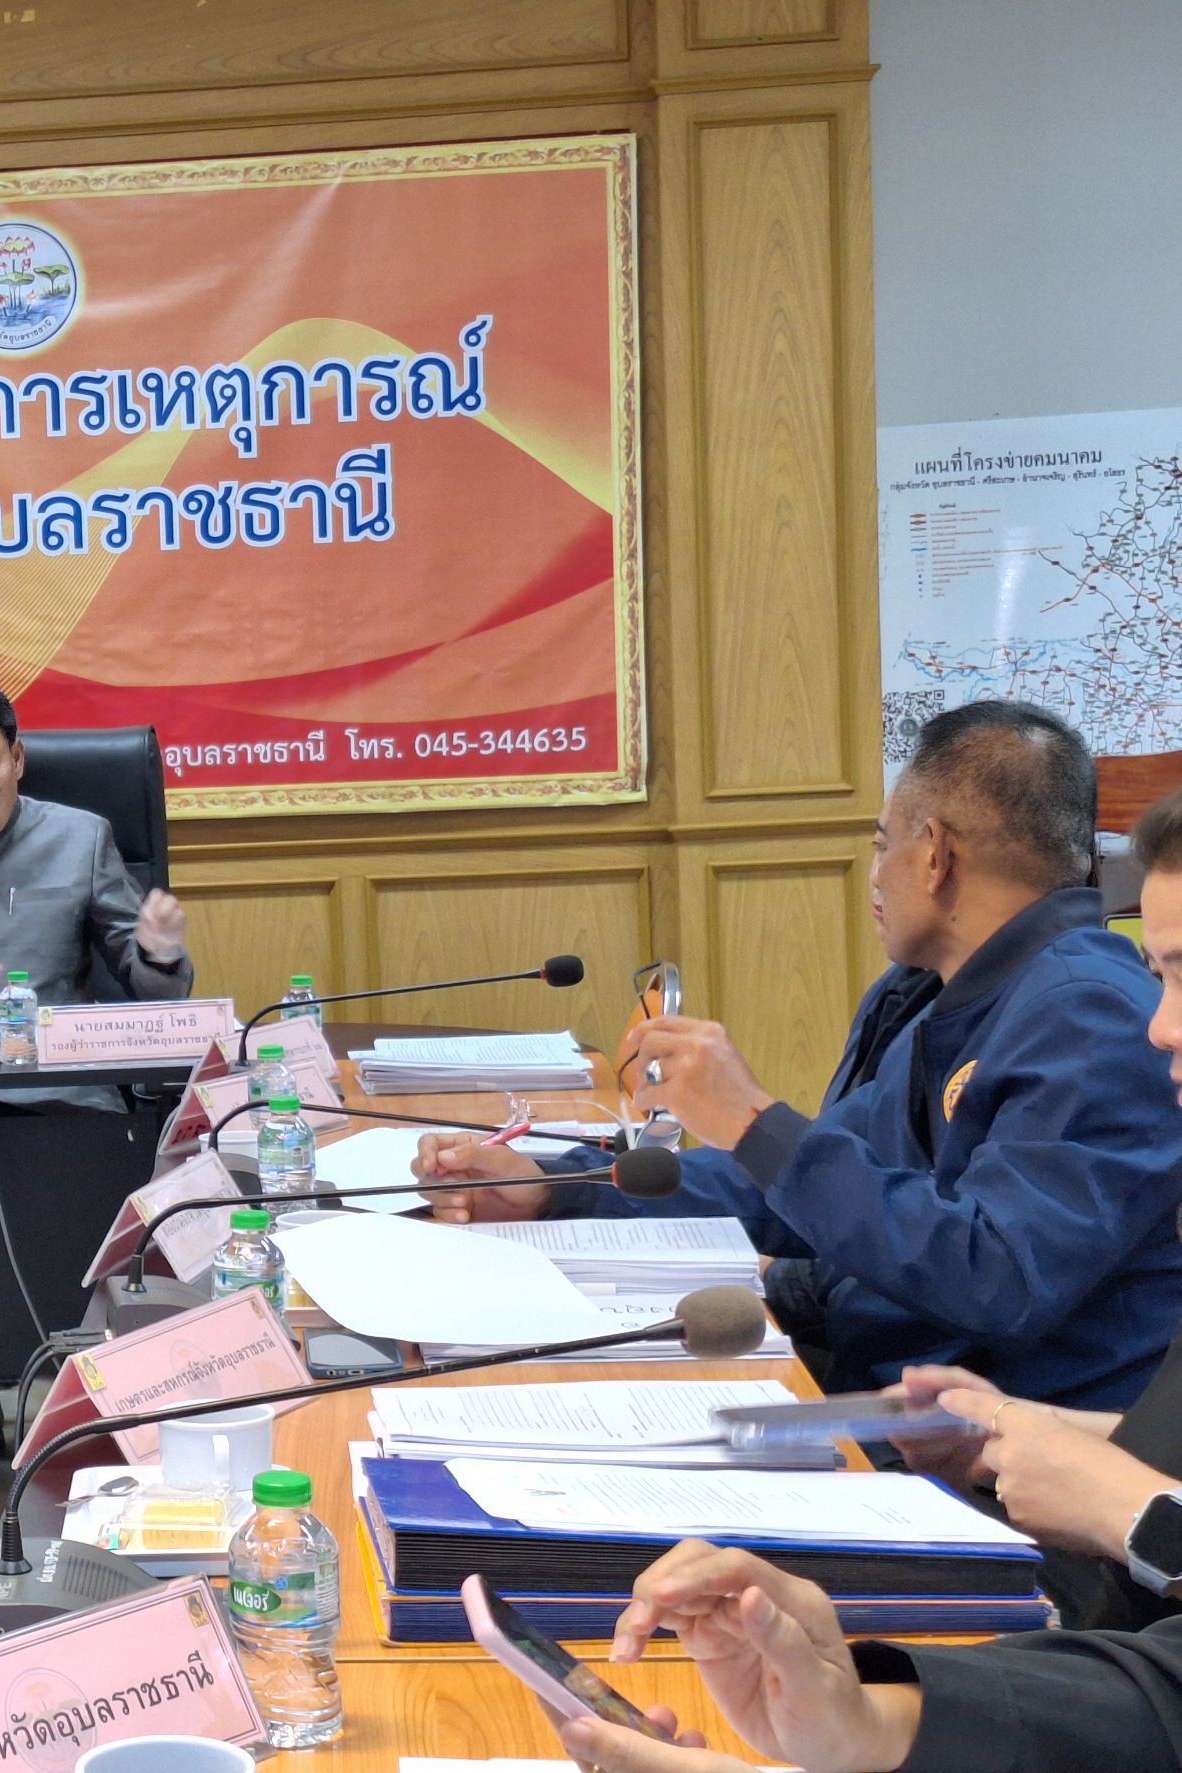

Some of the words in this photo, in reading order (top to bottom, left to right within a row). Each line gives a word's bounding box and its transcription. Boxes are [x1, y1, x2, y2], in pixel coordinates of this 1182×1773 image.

[344, 728, 404, 761] โทร.
[414, 726, 588, 759] 045-344635
[115, 1332, 276, 1413] เกษตรและสหกรณ์จังหวัดอุบลราชธานี
